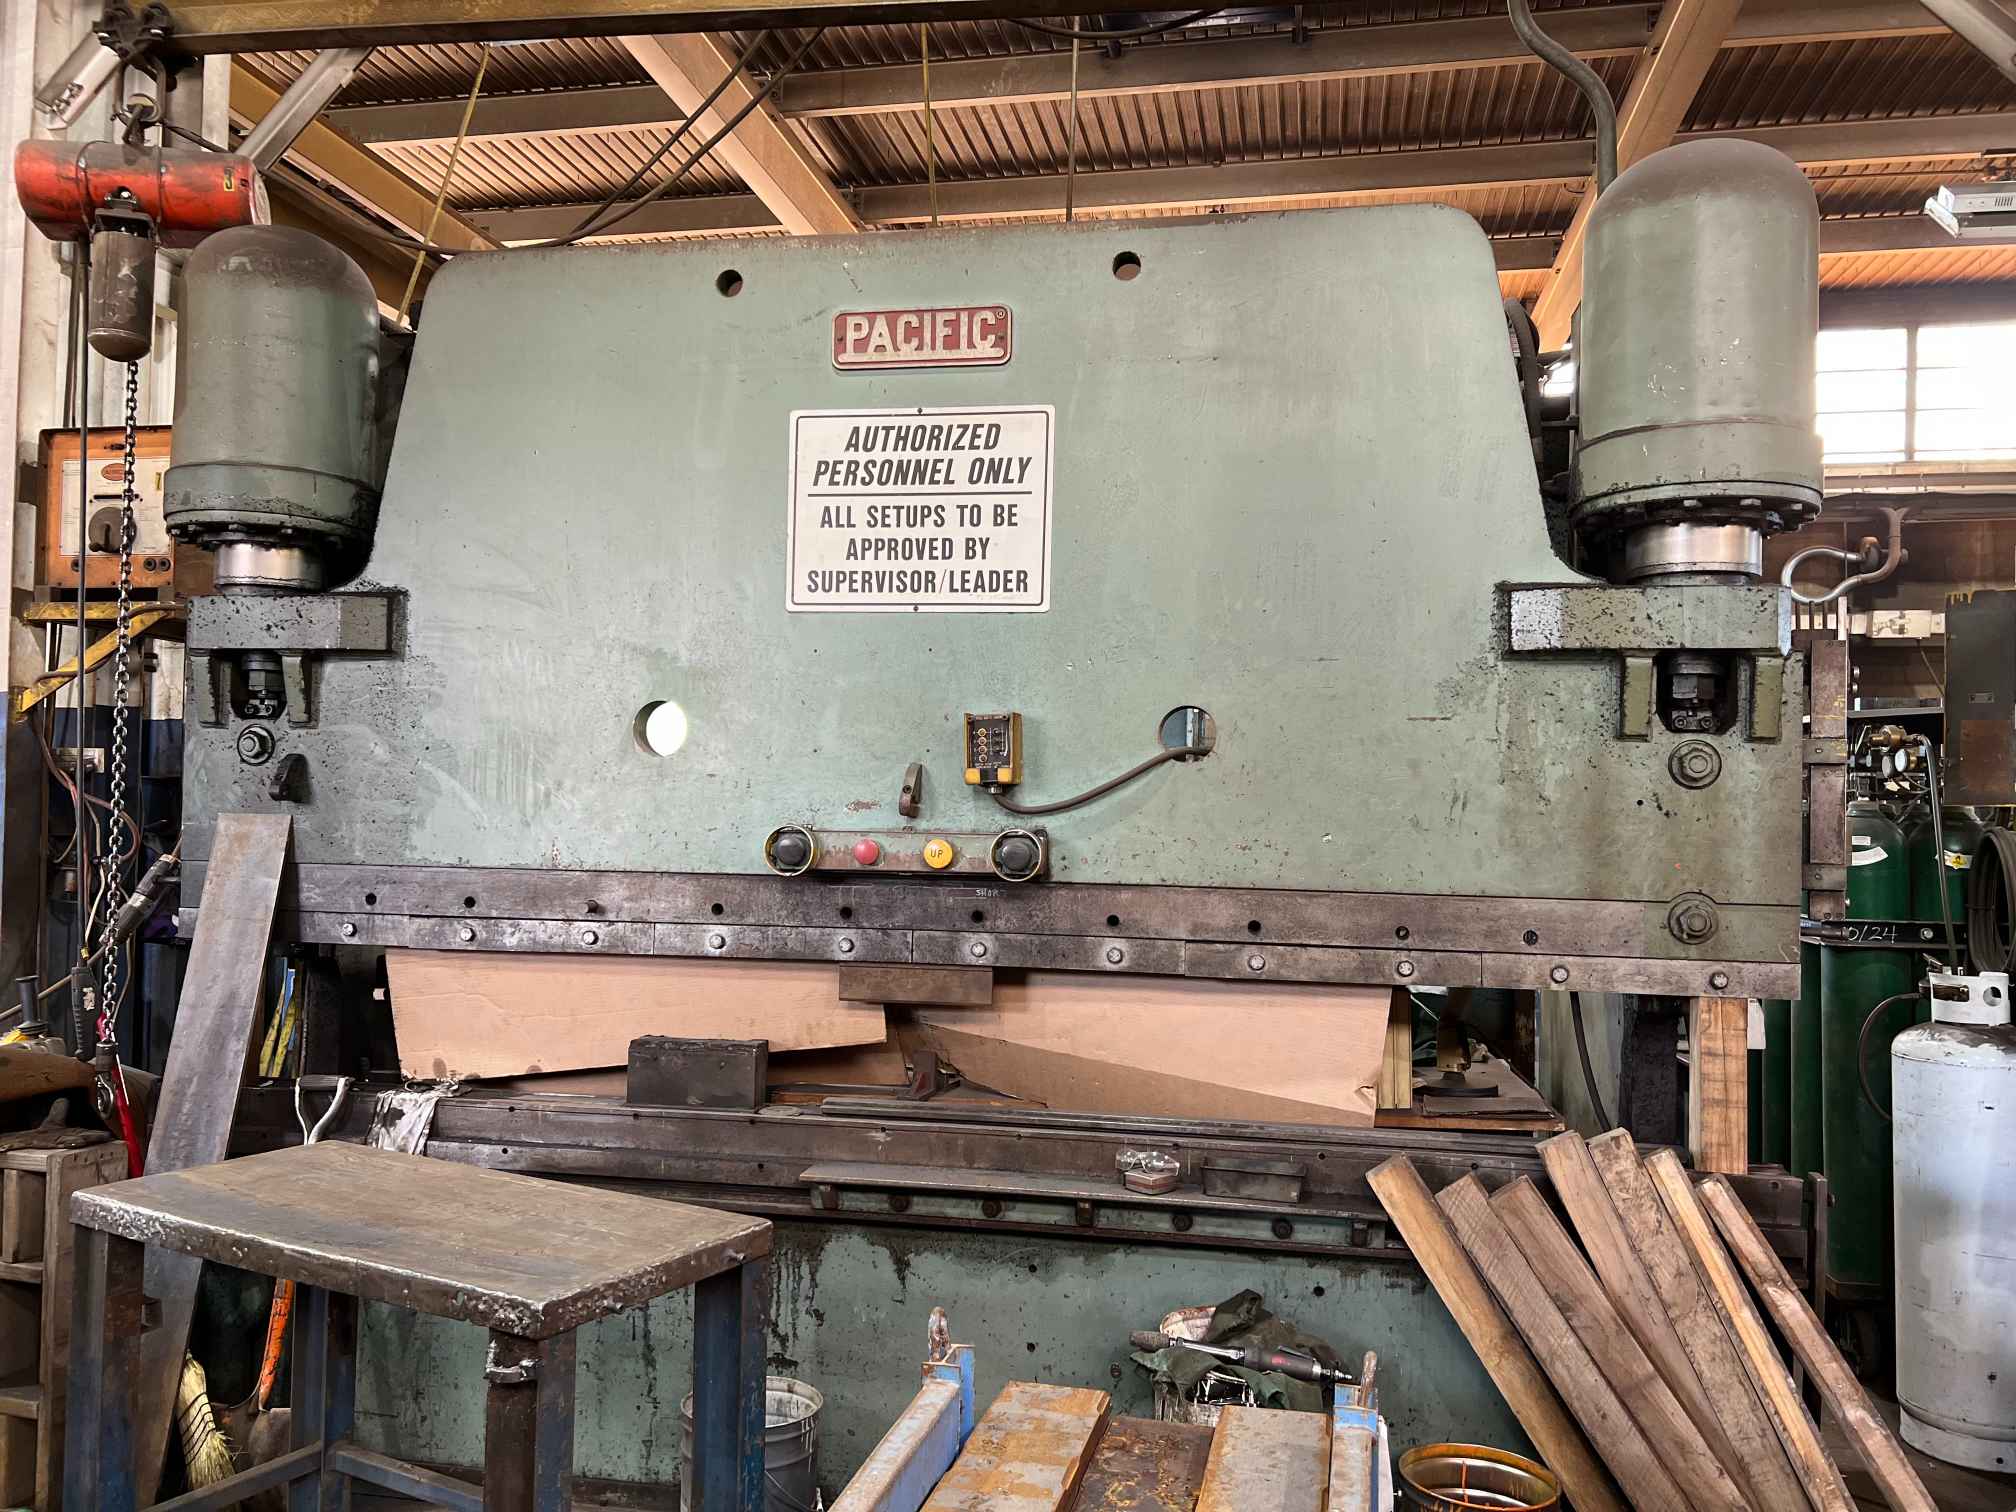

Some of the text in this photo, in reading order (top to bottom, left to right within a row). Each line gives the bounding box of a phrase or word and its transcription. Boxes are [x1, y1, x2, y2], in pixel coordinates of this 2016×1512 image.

[844, 310, 998, 356] PACIFIC
[844, 423, 1001, 453] AUTHORIZED
[812, 457, 1033, 487] PERSONNEL ONLY
[820, 504, 1018, 529] ALL SETUPS TO BE
[845, 537, 991, 562] APPROVED BY
[807, 569, 1029, 594] SUPERVISOR/LEADER
[930, 849, 944, 859] UP
